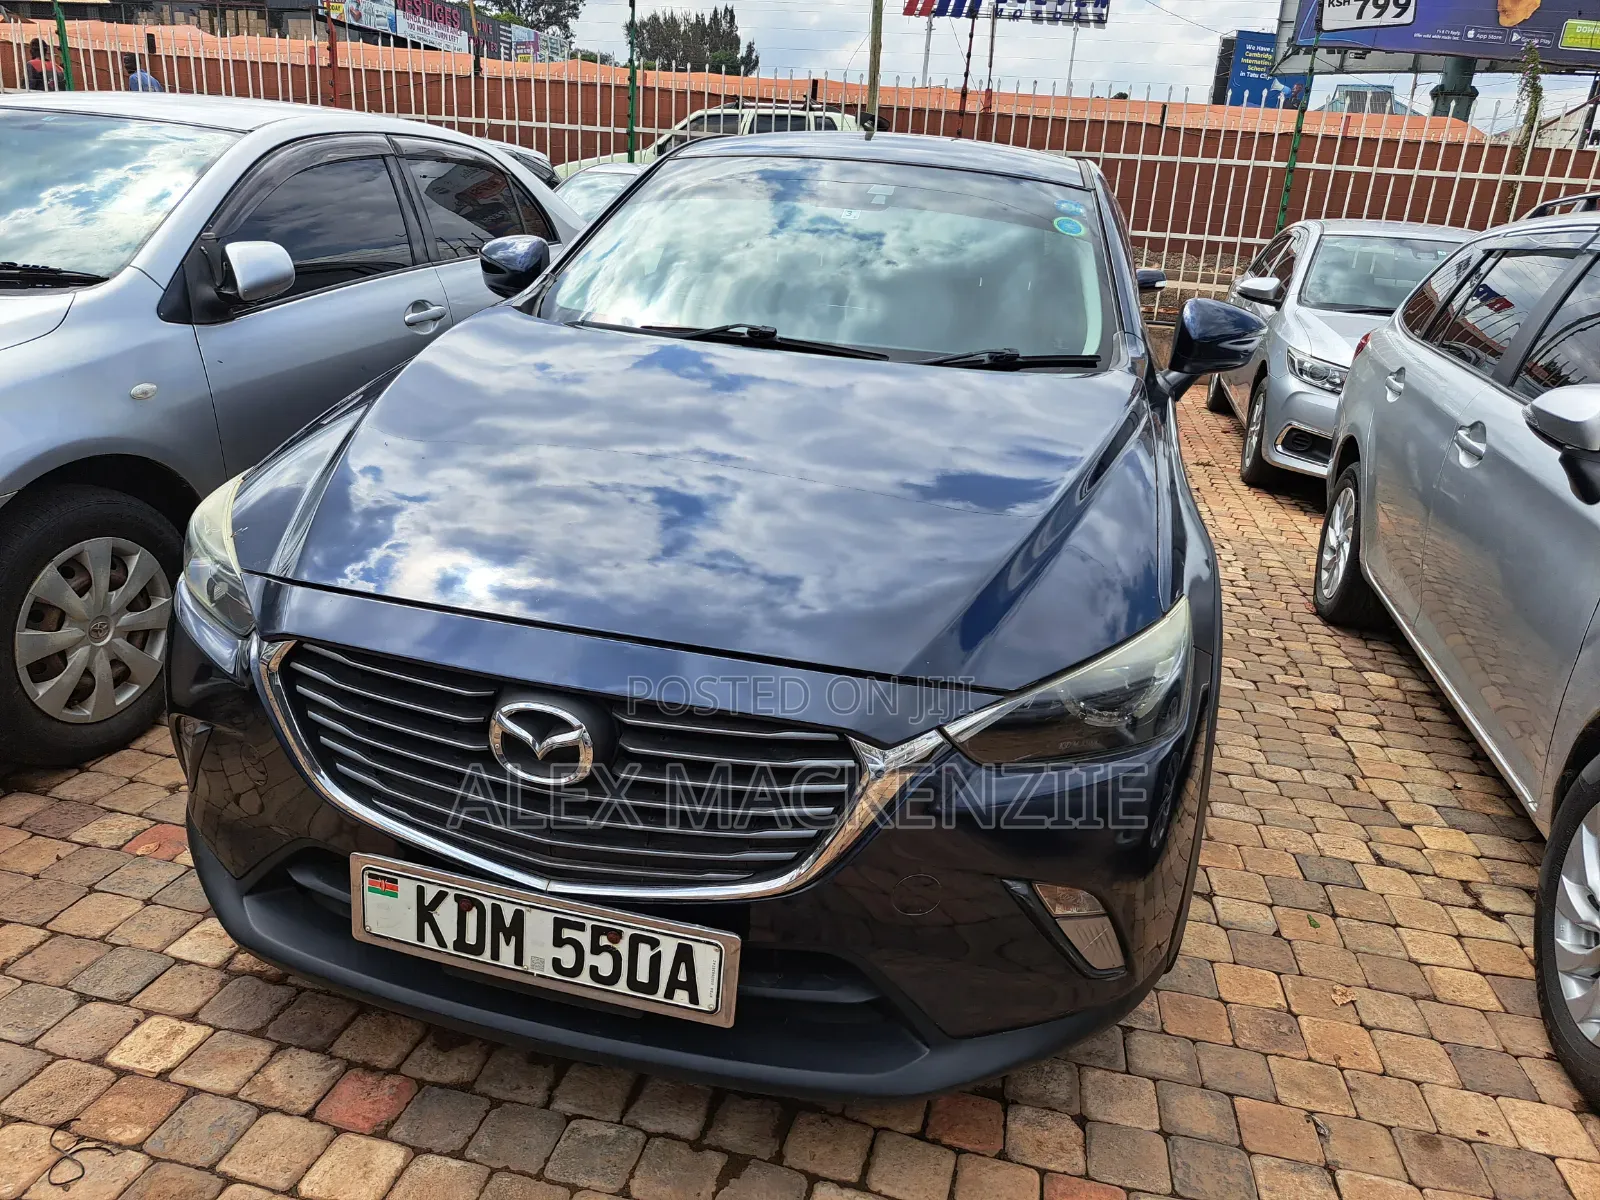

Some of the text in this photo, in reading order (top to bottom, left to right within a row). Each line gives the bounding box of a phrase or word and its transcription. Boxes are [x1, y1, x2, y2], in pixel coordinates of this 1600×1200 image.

[1353, 0, 1411, 20] 799
[1245, 51, 1272, 60] Cambridg
[416, 884, 701, 1006] KDM 550A
